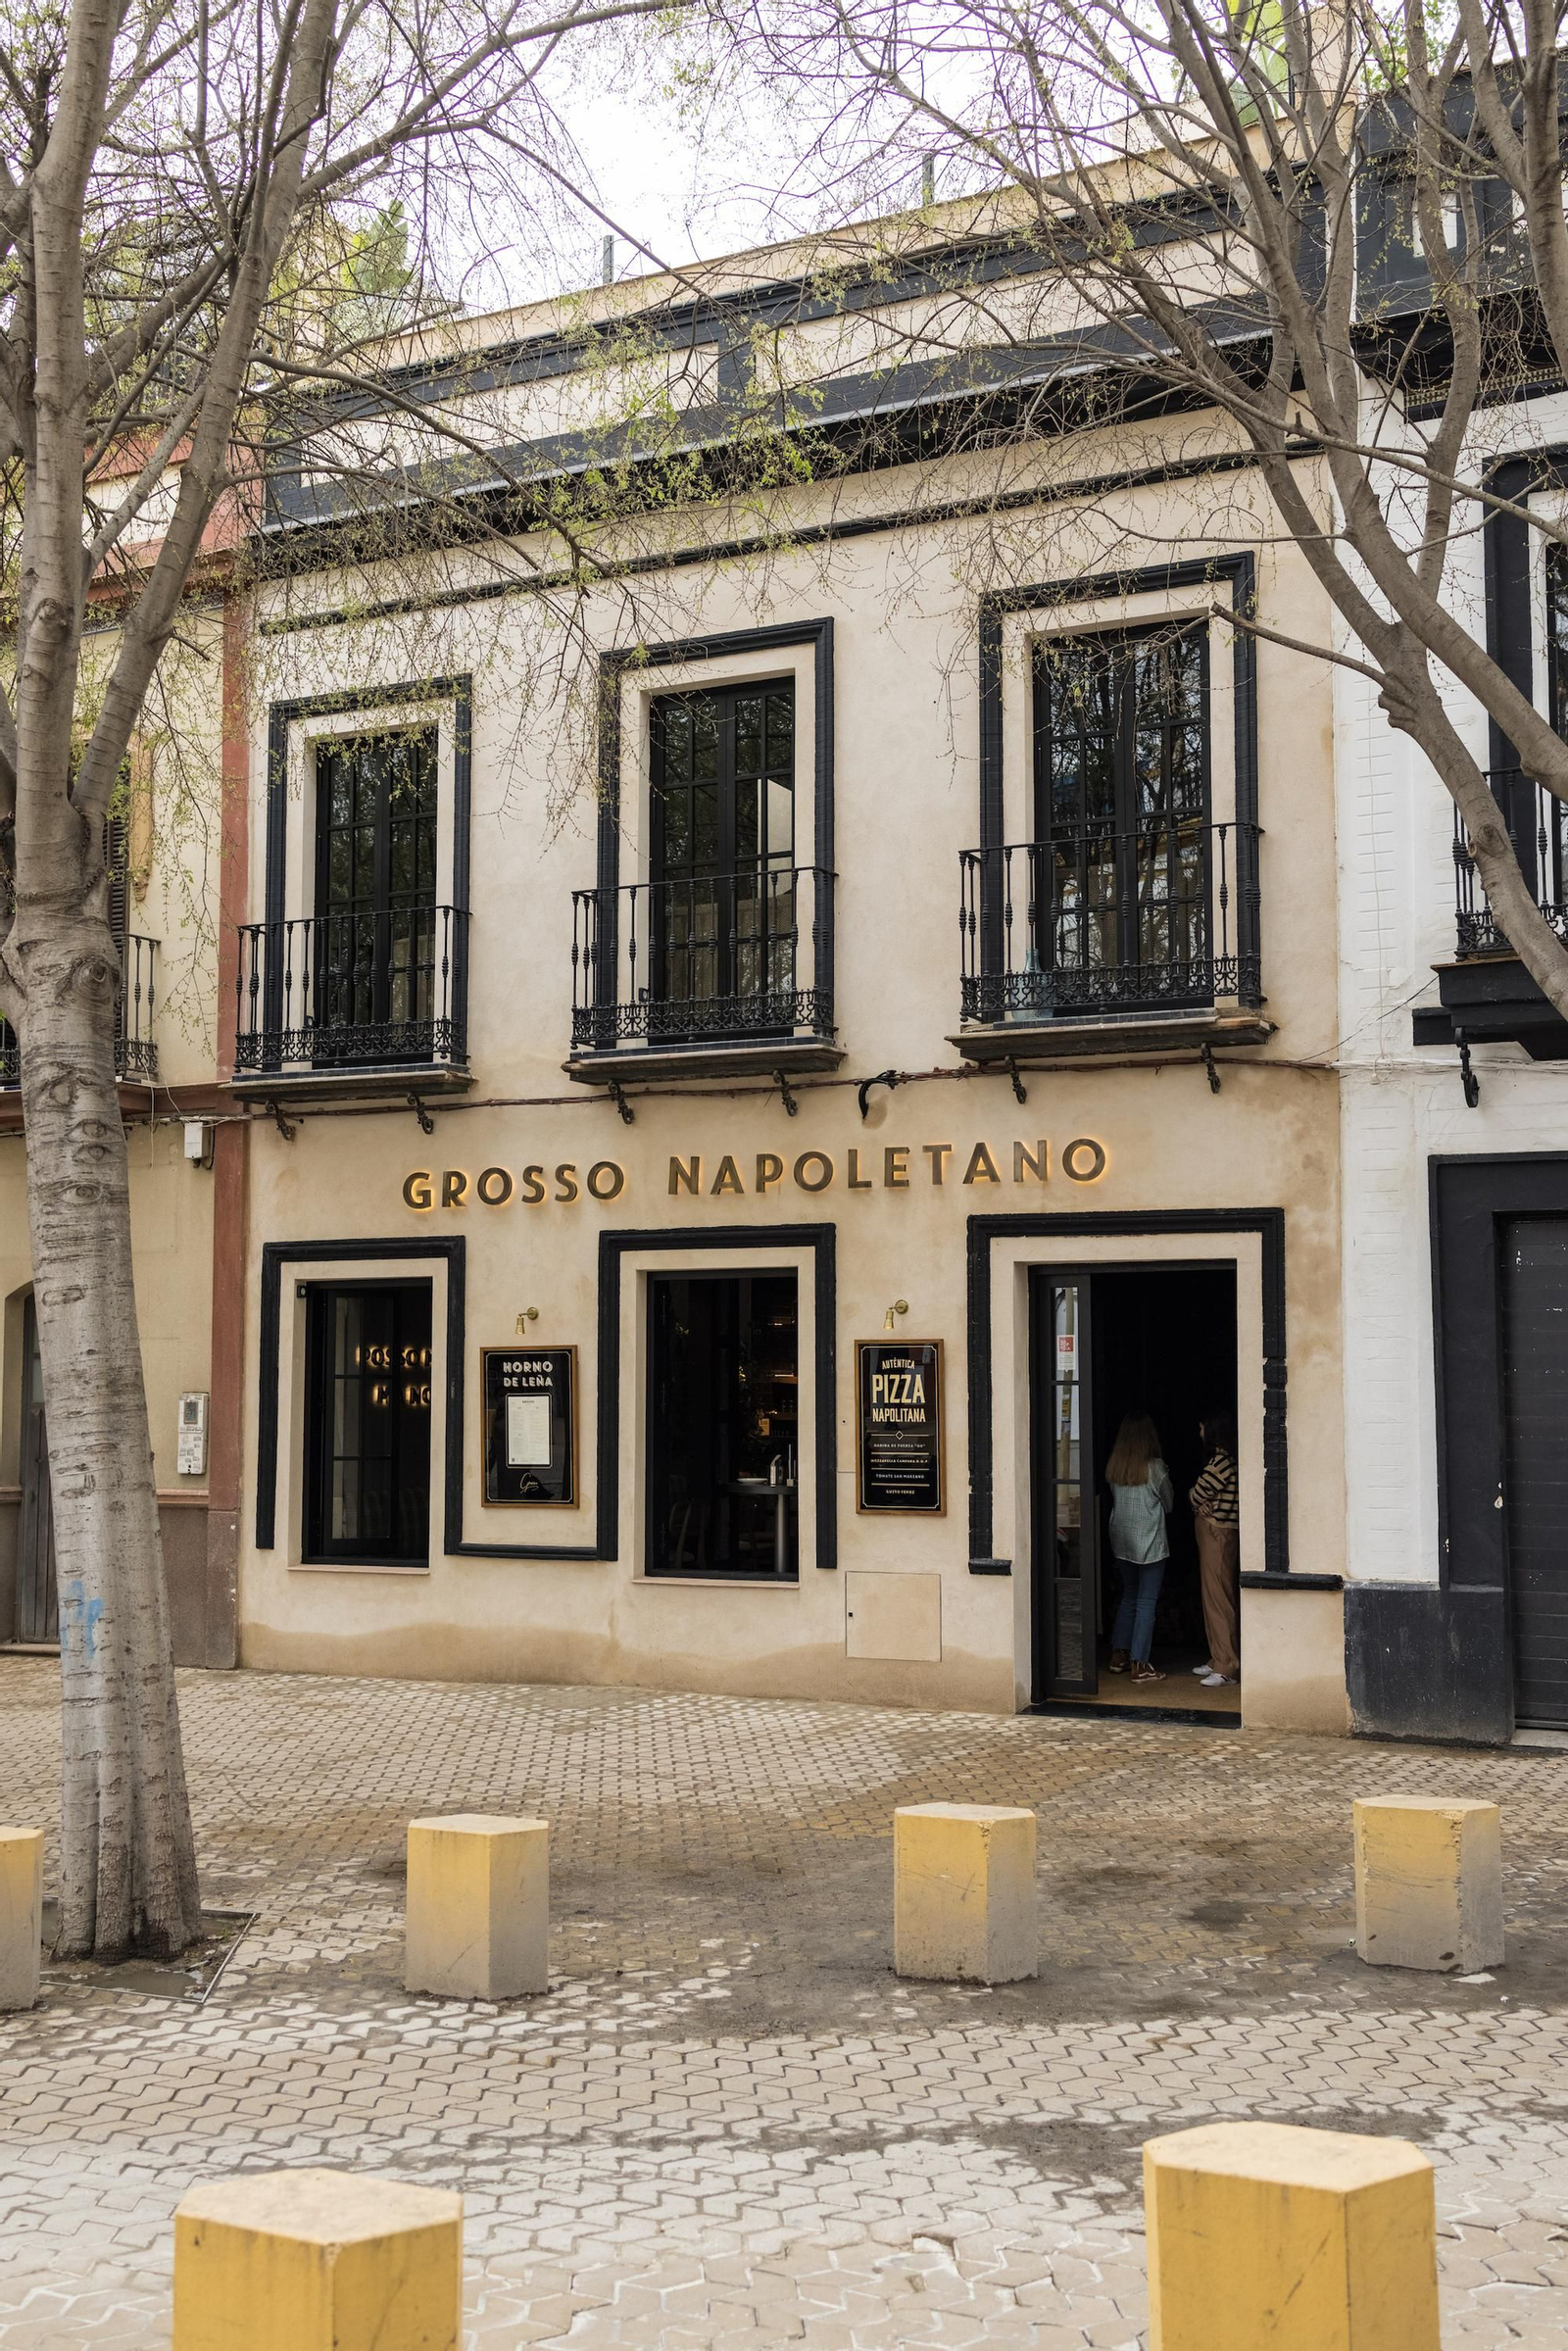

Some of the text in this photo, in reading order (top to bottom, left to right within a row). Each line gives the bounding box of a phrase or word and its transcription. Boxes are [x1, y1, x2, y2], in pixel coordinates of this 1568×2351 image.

[403, 1138, 1105, 1210] GROSSO NAPOLETANO
[503, 1361, 554, 1373] HORNO
[882, 1357, 915, 1370] AUTÉNTICA
[504, 1375, 553, 1387] DE LEÑA
[872, 1374, 925, 1403] PIZZA
[872, 1407, 926, 1423] NAPOLITANA
